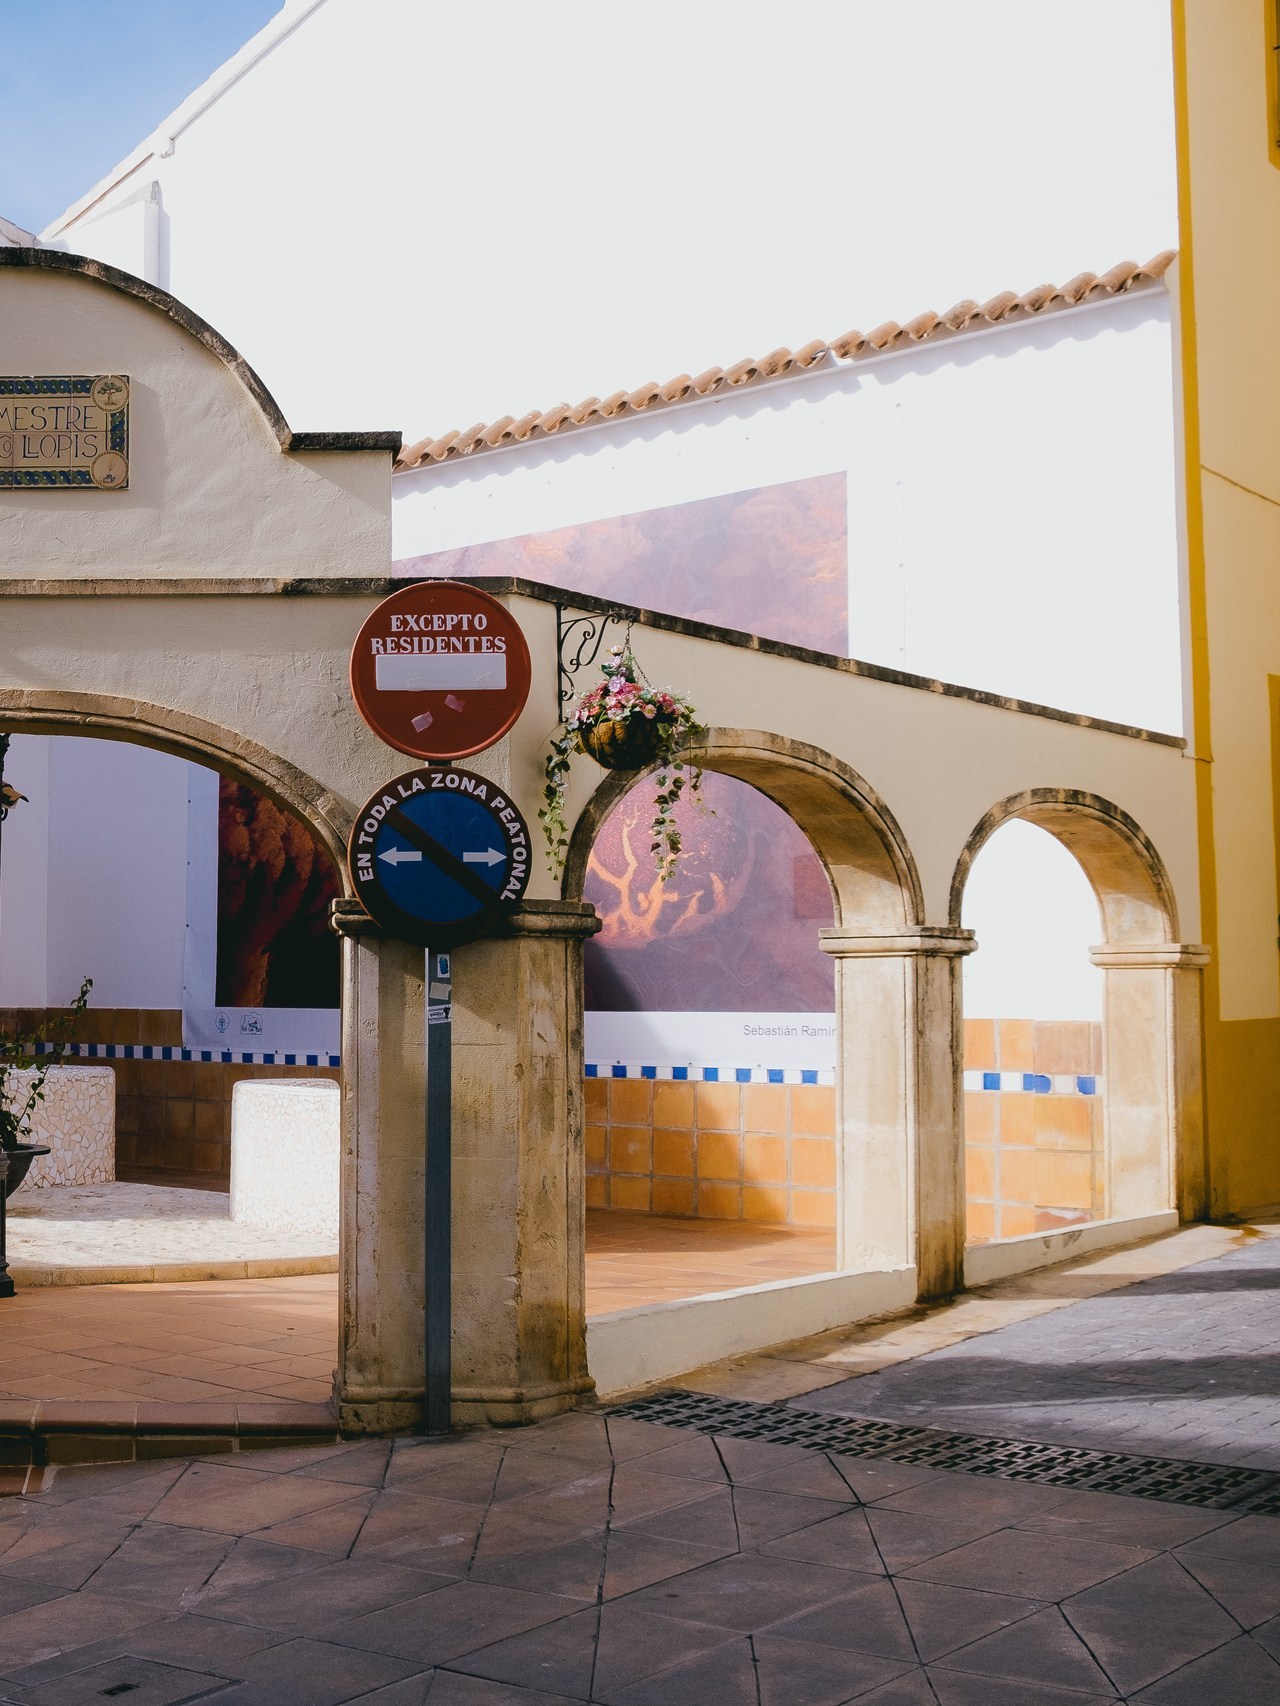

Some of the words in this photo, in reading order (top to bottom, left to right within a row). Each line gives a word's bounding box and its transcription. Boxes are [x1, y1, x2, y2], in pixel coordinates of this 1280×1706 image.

[22, 434, 98, 460] LLOPIS
[390, 613, 488, 632] EXCEPTO
[370, 636, 507, 655] RESIDENTES
[398, 776, 425, 800] LA
[431, 773, 488, 800] ZONA
[358, 794, 398, 845] TODA
[490, 796, 527, 903] PEATONAL
[357, 853, 375, 882] EN
[743, 1024, 798, 1036] Sebastián
